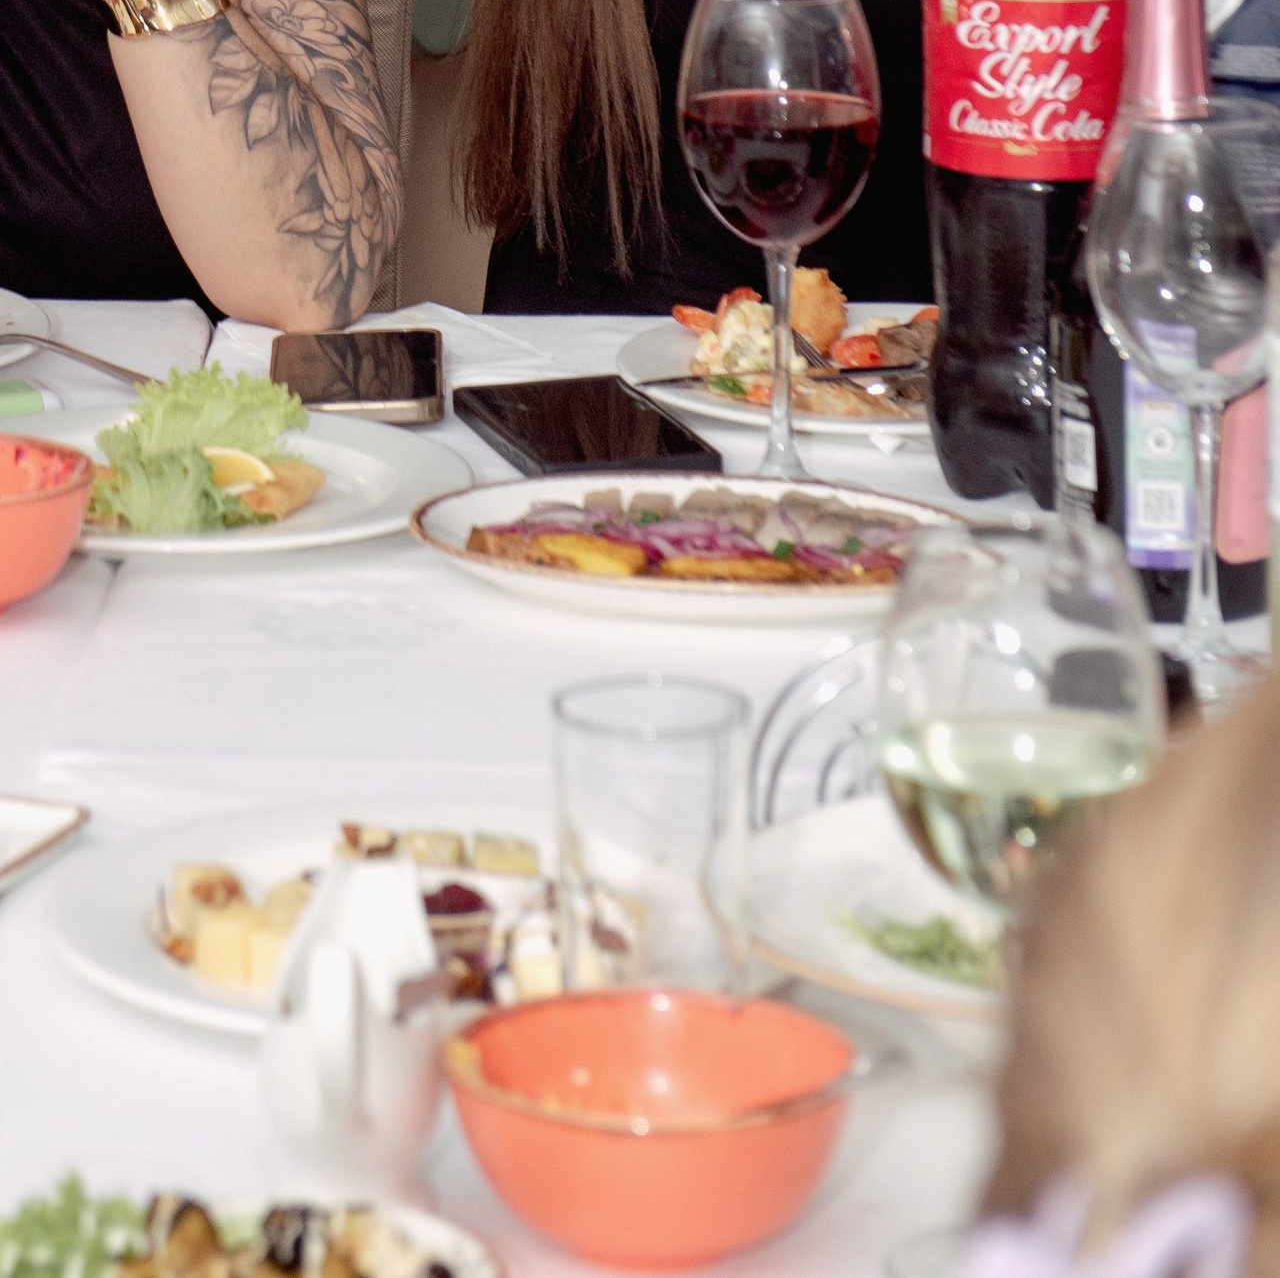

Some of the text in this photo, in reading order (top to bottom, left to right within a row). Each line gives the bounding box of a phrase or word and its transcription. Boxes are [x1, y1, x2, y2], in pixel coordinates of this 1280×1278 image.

[955, 0, 1110, 55] Export
[971, 49, 1083, 116] Style
[948, 99, 1105, 142] Classic Cola
